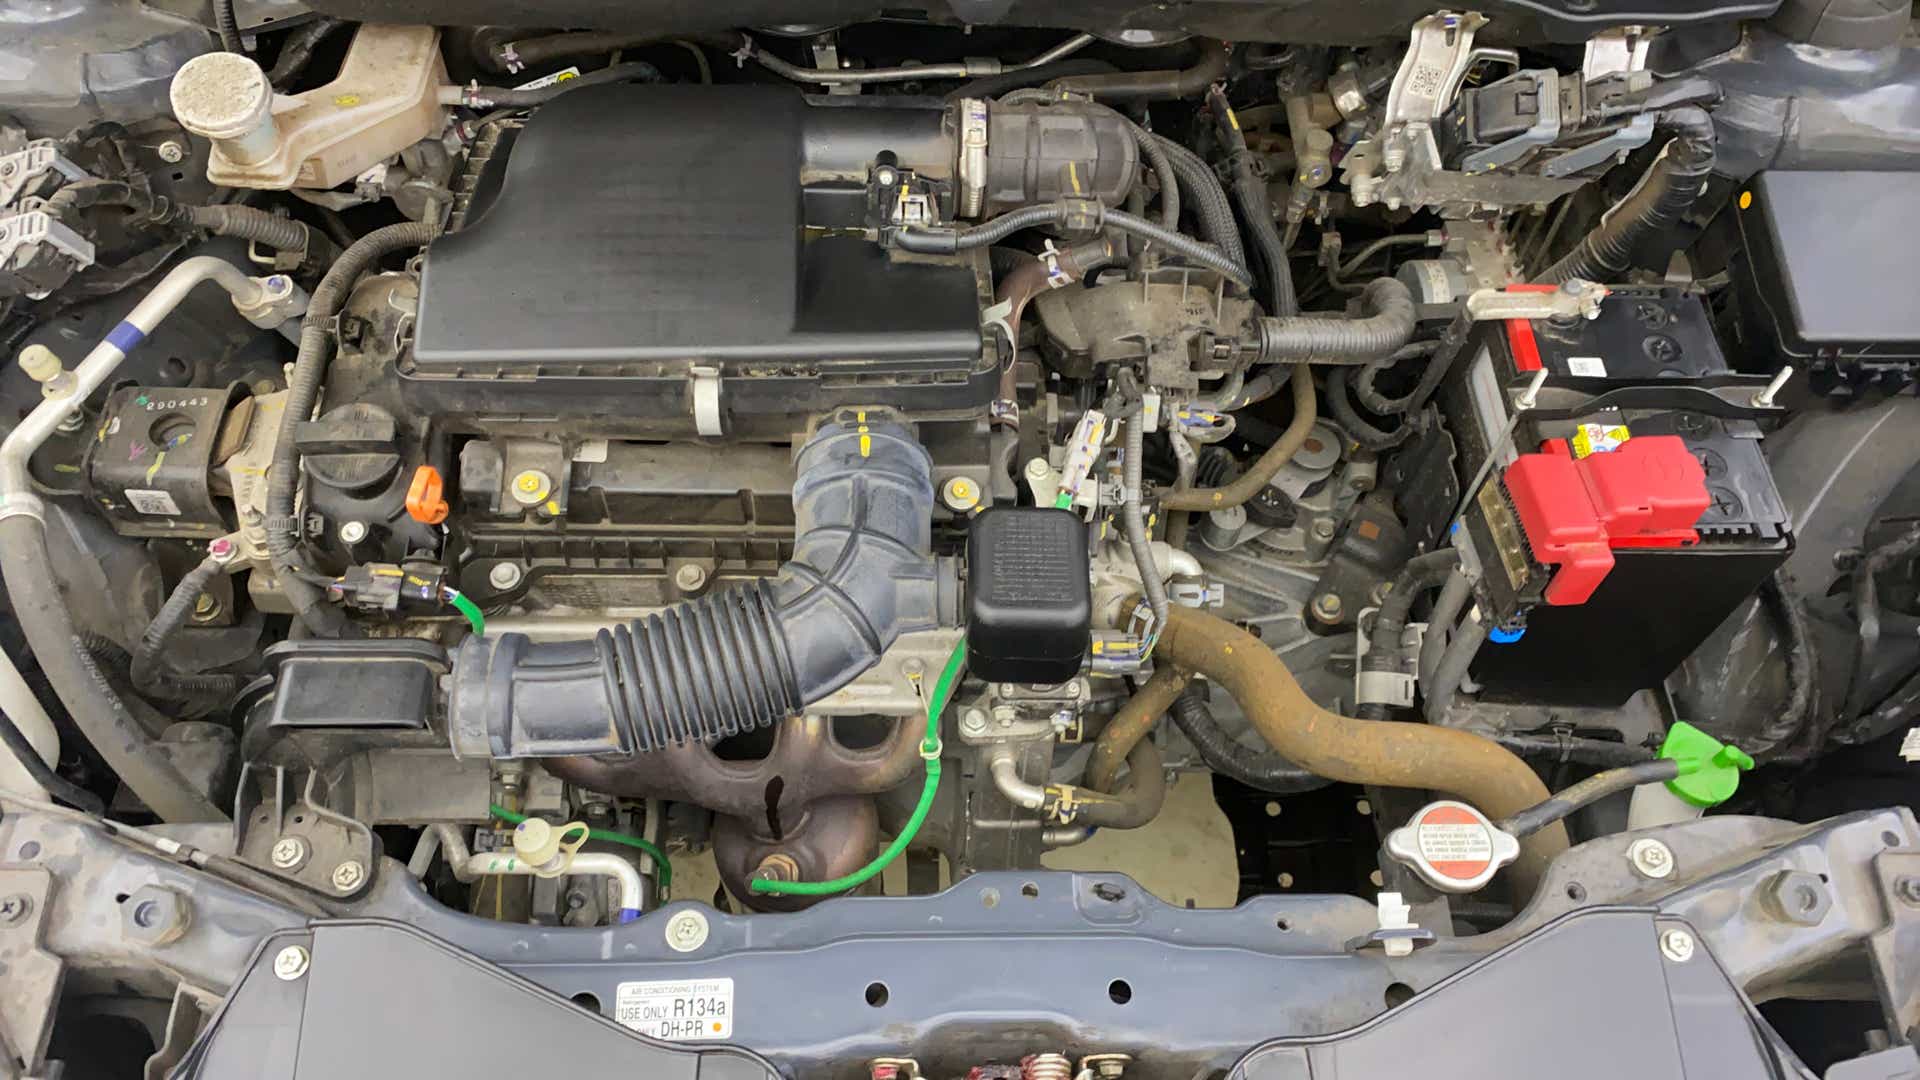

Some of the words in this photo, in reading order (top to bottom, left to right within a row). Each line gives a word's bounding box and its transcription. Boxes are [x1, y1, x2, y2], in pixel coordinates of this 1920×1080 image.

[621, 1006, 640, 1019] USE
[643, 1006, 668, 1019] ONLY
[673, 998, 726, 1017] R134a
[661, 1020, 704, 1037] DH-PR
